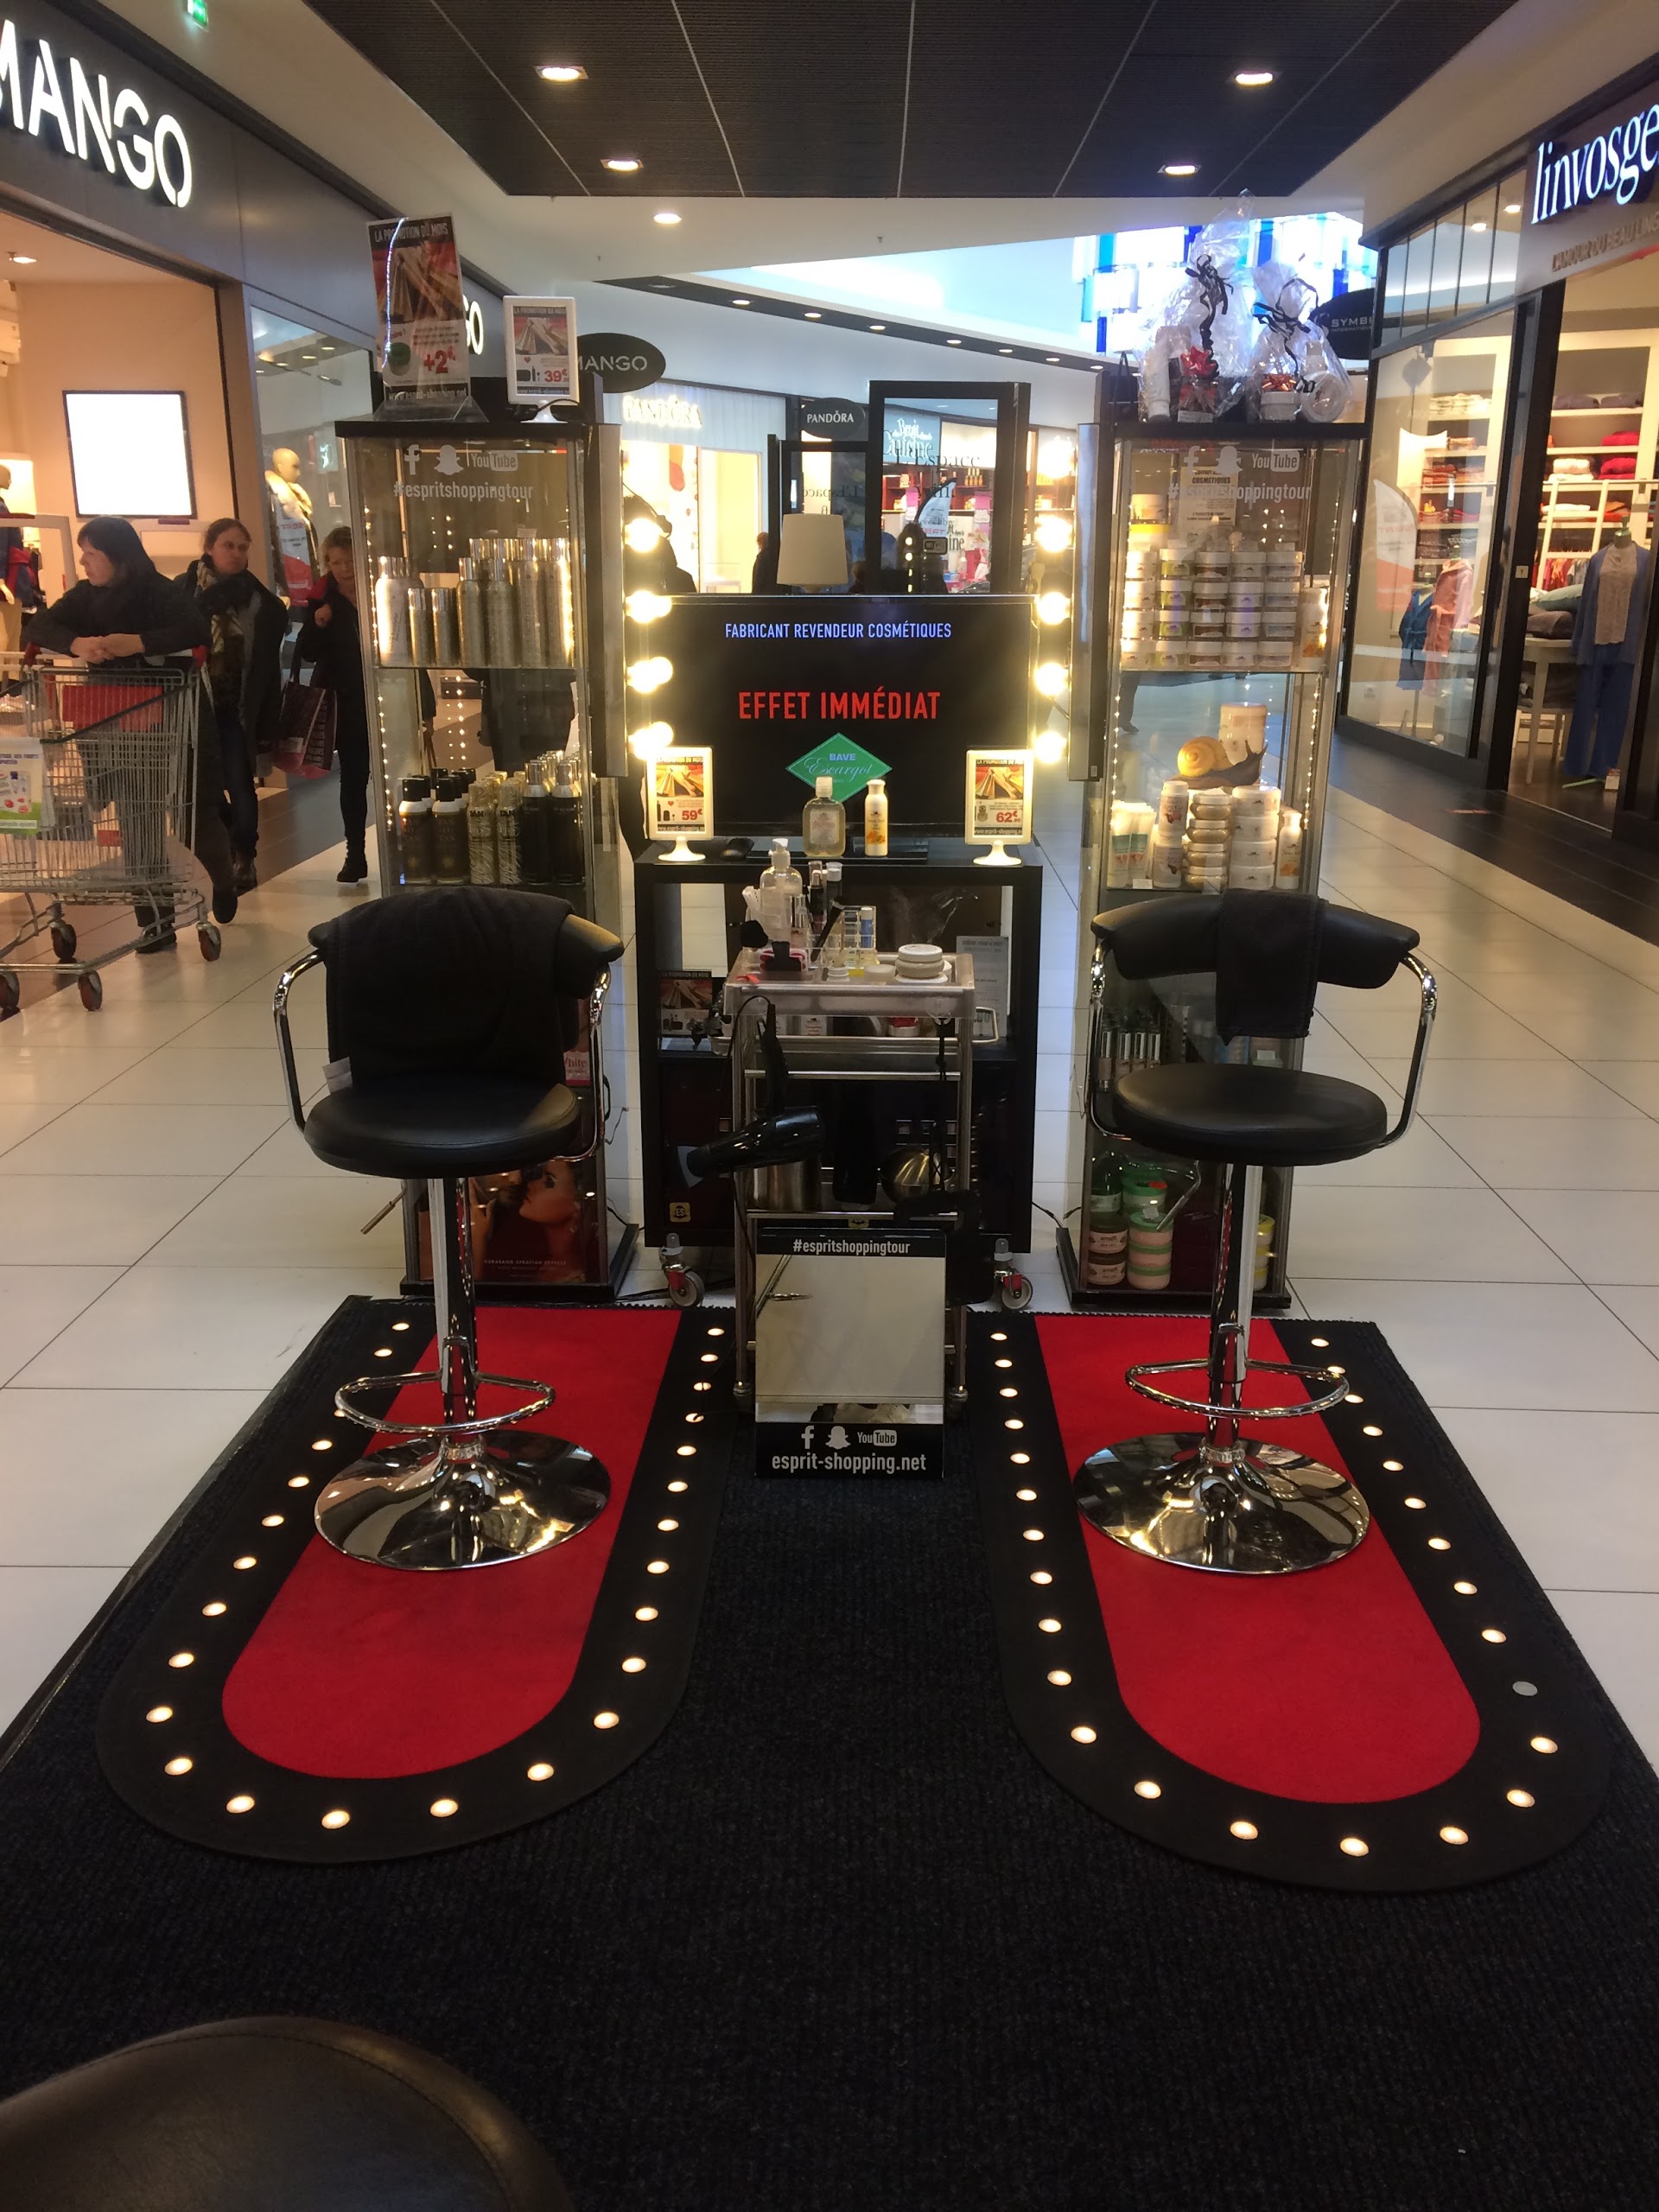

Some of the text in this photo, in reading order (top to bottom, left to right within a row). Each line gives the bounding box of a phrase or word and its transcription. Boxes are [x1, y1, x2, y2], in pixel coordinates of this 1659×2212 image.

[0, 19, 193, 208] MANGO
[431, 222, 448, 236] MOIS
[471, 452, 518, 470] YouTube
[1252, 452, 1300, 471] YouTube
[394, 480, 534, 502] #espritshoppingtour
[725, 620, 951, 639] FABRICANT REVENDEUR COSMÉTIQUES
[738, 686, 941, 719] EFFET IMMÉDIAT
[829, 753, 856, 761] BAVE
[792, 1239, 911, 1256] #espritshoppingtour
[857, 1430, 898, 1446] YouTube
[772, 1452, 926, 1475] esprit-shopping.net
